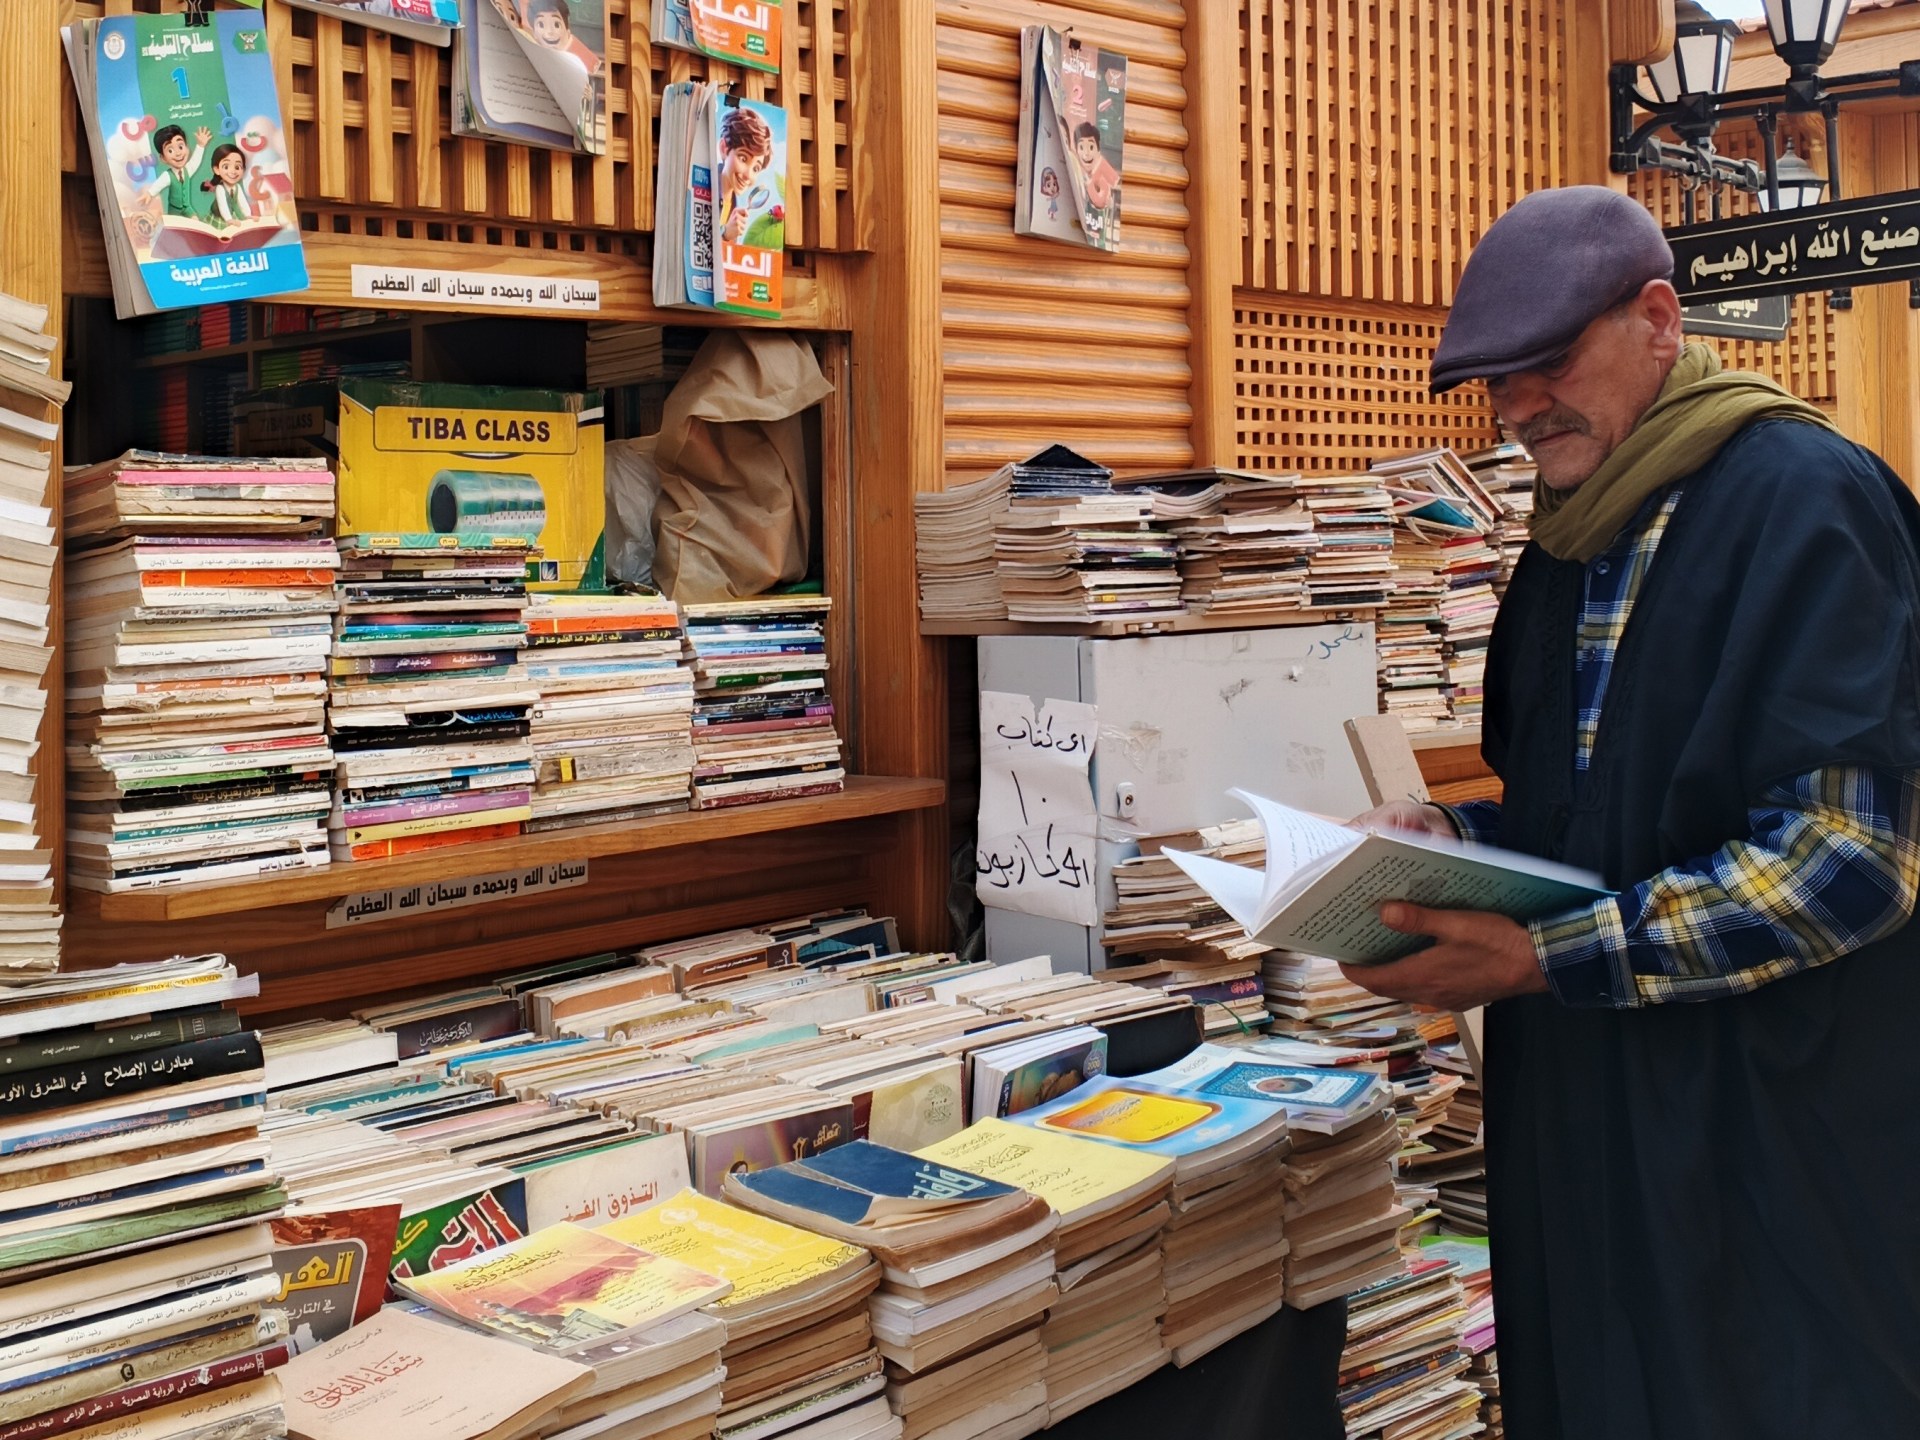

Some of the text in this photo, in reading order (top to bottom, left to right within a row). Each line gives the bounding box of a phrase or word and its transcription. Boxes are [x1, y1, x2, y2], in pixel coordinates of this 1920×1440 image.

[170, 66, 190, 99] 1
[1073, 84, 1083, 105] 2
[1690, 216, 1919, 286] صنع الله إبراهيم
[170, 252, 270, 287] اللغة العربية
[371, 274, 597, 306] سبحان الله وبحمده سبحان الله العظيم
[408, 417, 550, 443] TIBA CLASS
[997, 715, 1054, 750] كتاب
[346, 863, 586, 921] سبحان الله وبحمده سبحان الله العظيم
[104, 1062, 148, 1087] الإصلاح
[151, 1056, 194, 1074] مبادرات
[30, 1077, 67, 1099] الشرق
[71, 1072, 88, 1093] في
[561, 1181, 660, 1224] التذوق الفن
[322, 1299, 336, 1312] في
[121, 1386, 151, 1407] المصرية
[152, 1381, 175, 1398] الرواية
[176, 1378, 188, 1393] في
